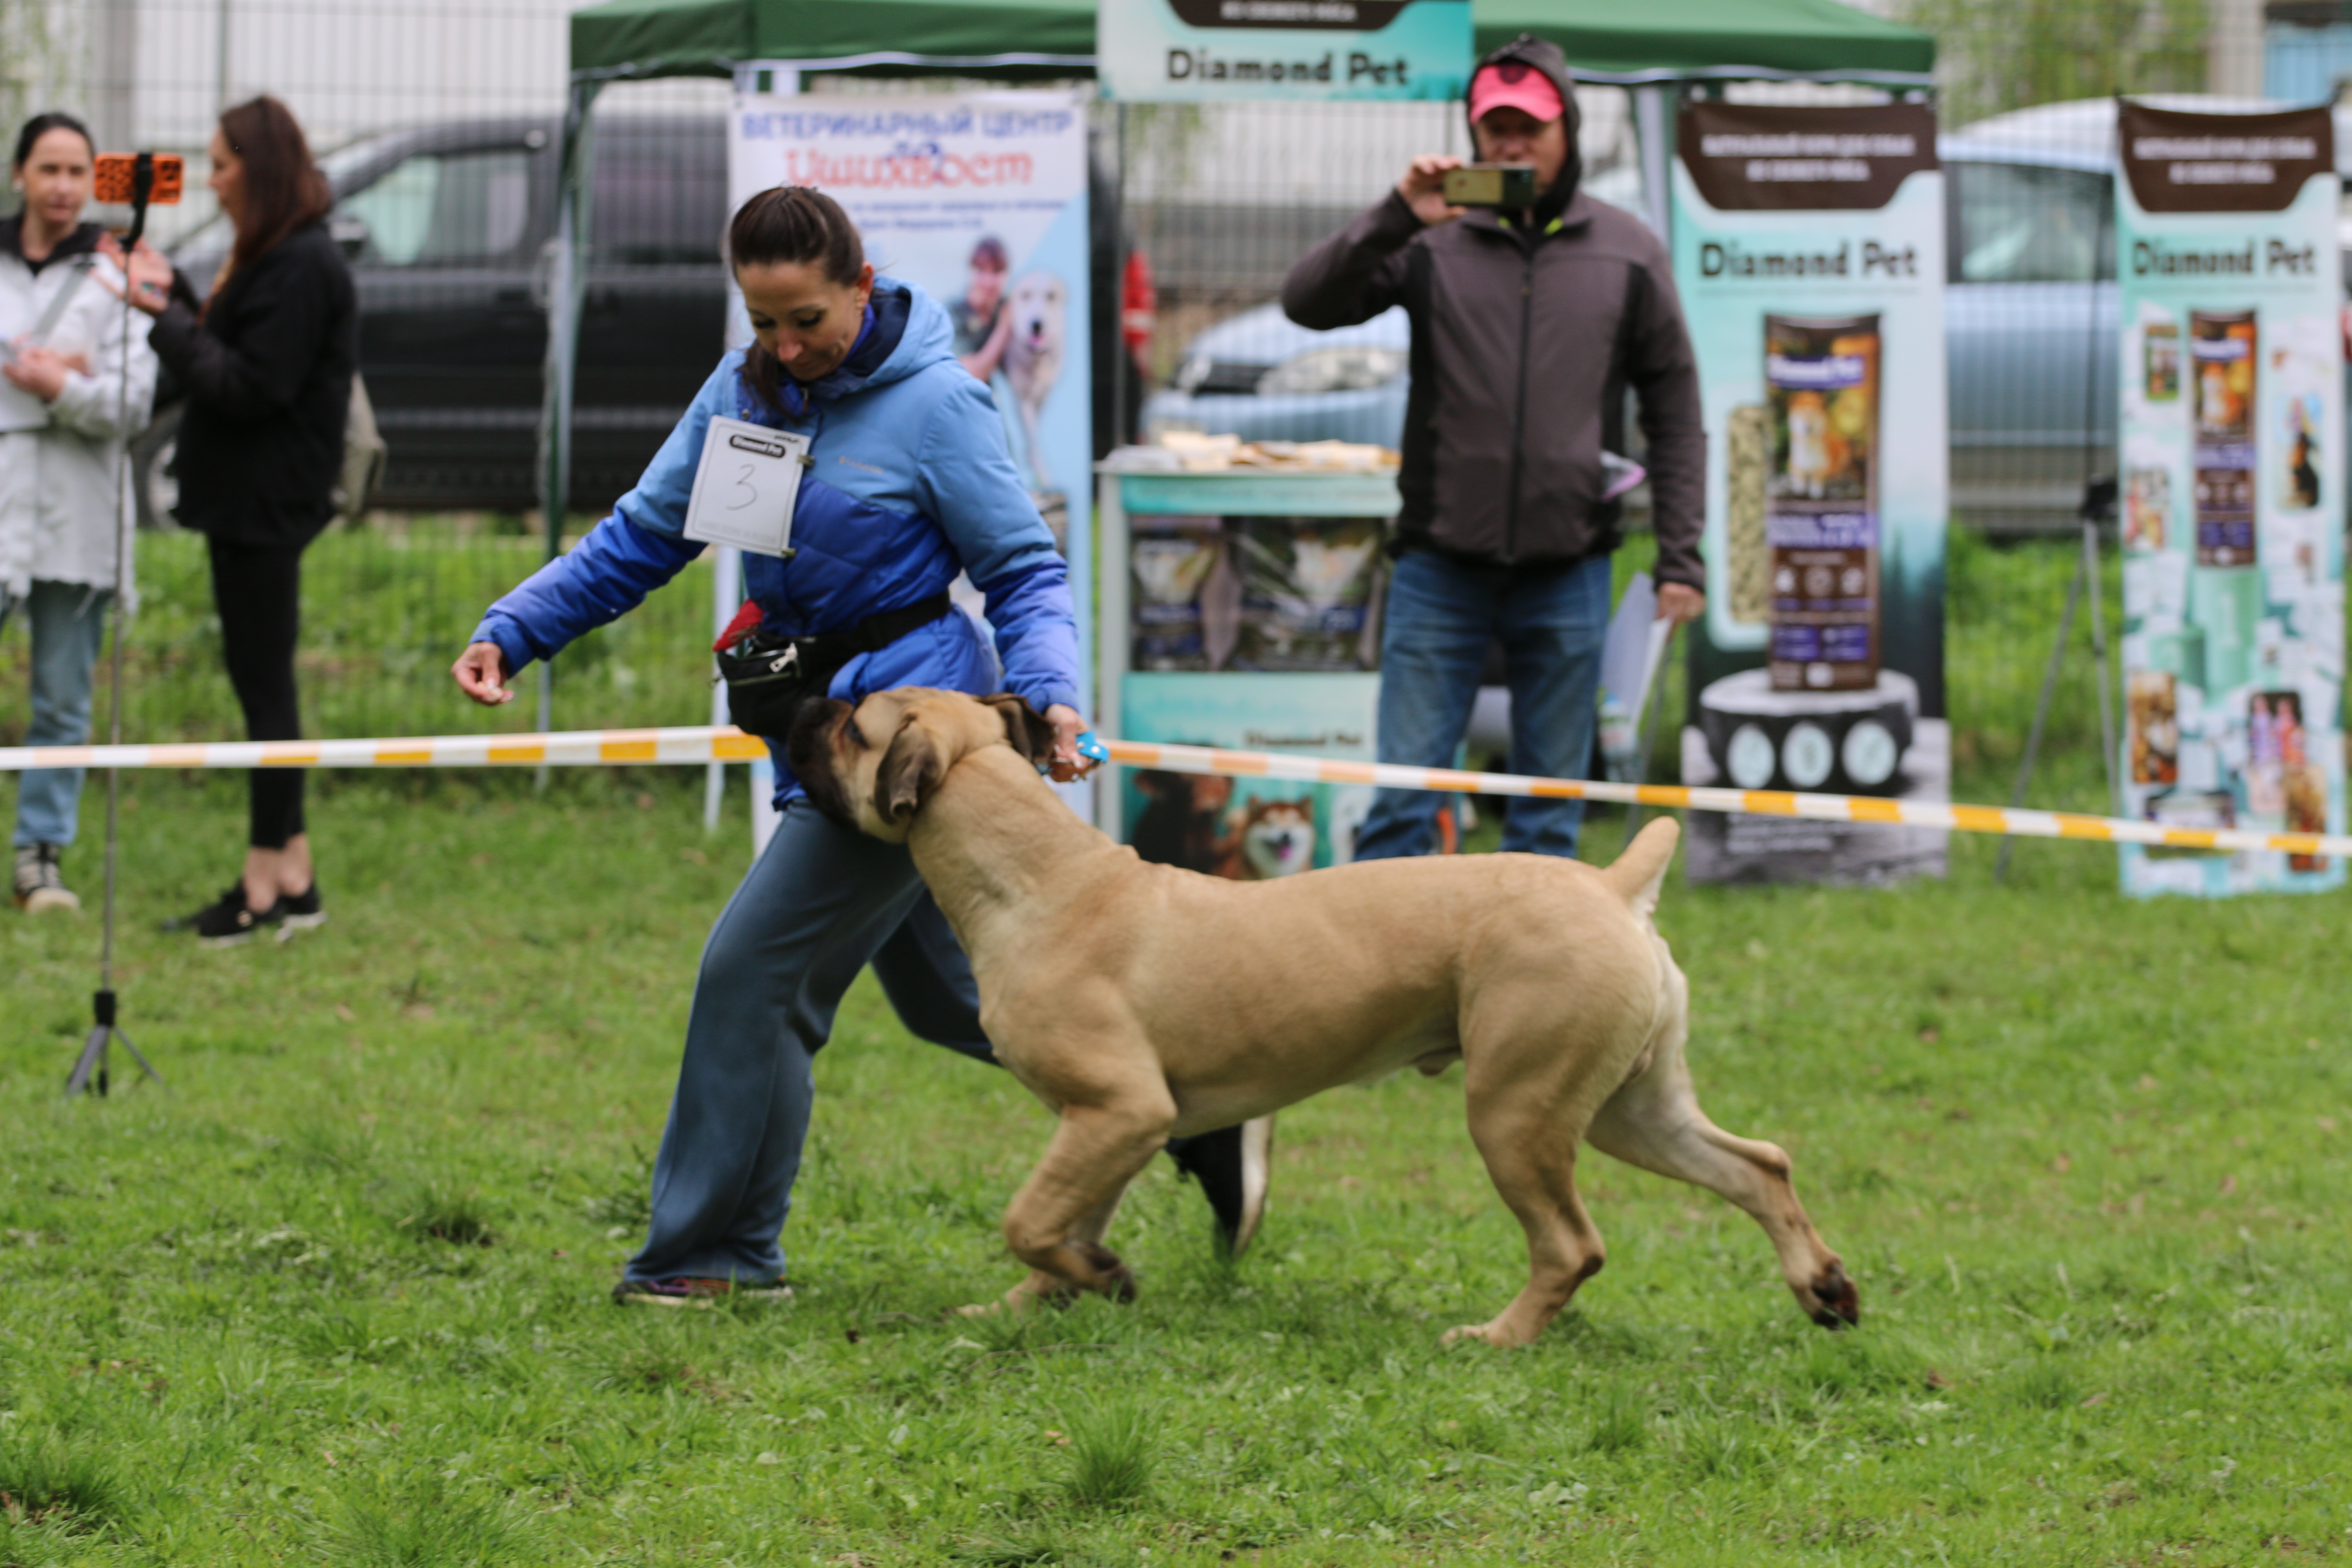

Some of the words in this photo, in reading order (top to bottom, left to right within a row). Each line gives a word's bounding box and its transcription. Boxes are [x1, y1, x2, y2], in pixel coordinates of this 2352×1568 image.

[1167, 49, 1333, 83] Diamond
[1348, 52, 1409, 85] Pet
[742, 107, 974, 138] ВЕТЕРИНАРНЫЙ
[982, 109, 1074, 138] ЦЕНТР
[1700, 239, 1849, 279] Diamond
[1862, 242, 1917, 277] Pet
[2133, 236, 2256, 276] Diamond
[2266, 239, 2317, 276] Pet
[726, 462, 757, 511] 3
